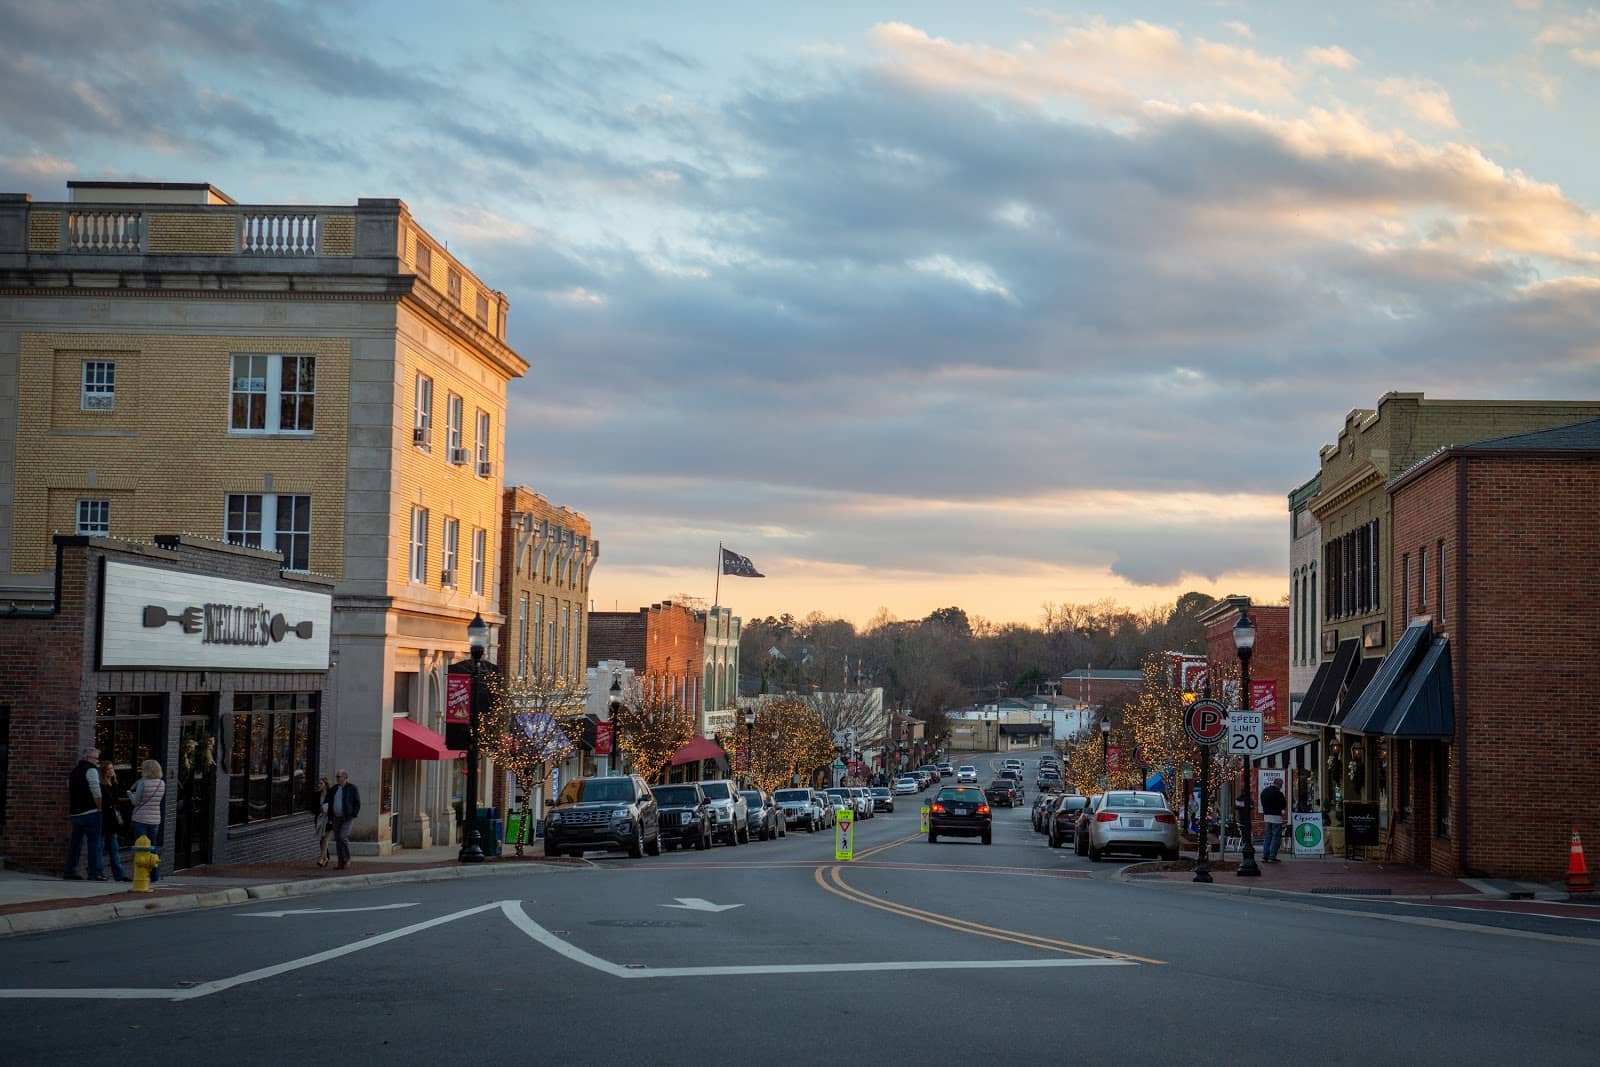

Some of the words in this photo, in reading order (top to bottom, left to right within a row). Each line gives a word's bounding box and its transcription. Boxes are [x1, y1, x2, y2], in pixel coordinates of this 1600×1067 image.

[202, 603, 271, 647] NELLIE'S
[1200, 710, 1219, 732] P
[1231, 715, 1261, 723] SPEED
[1231, 733, 1259, 750] 20
